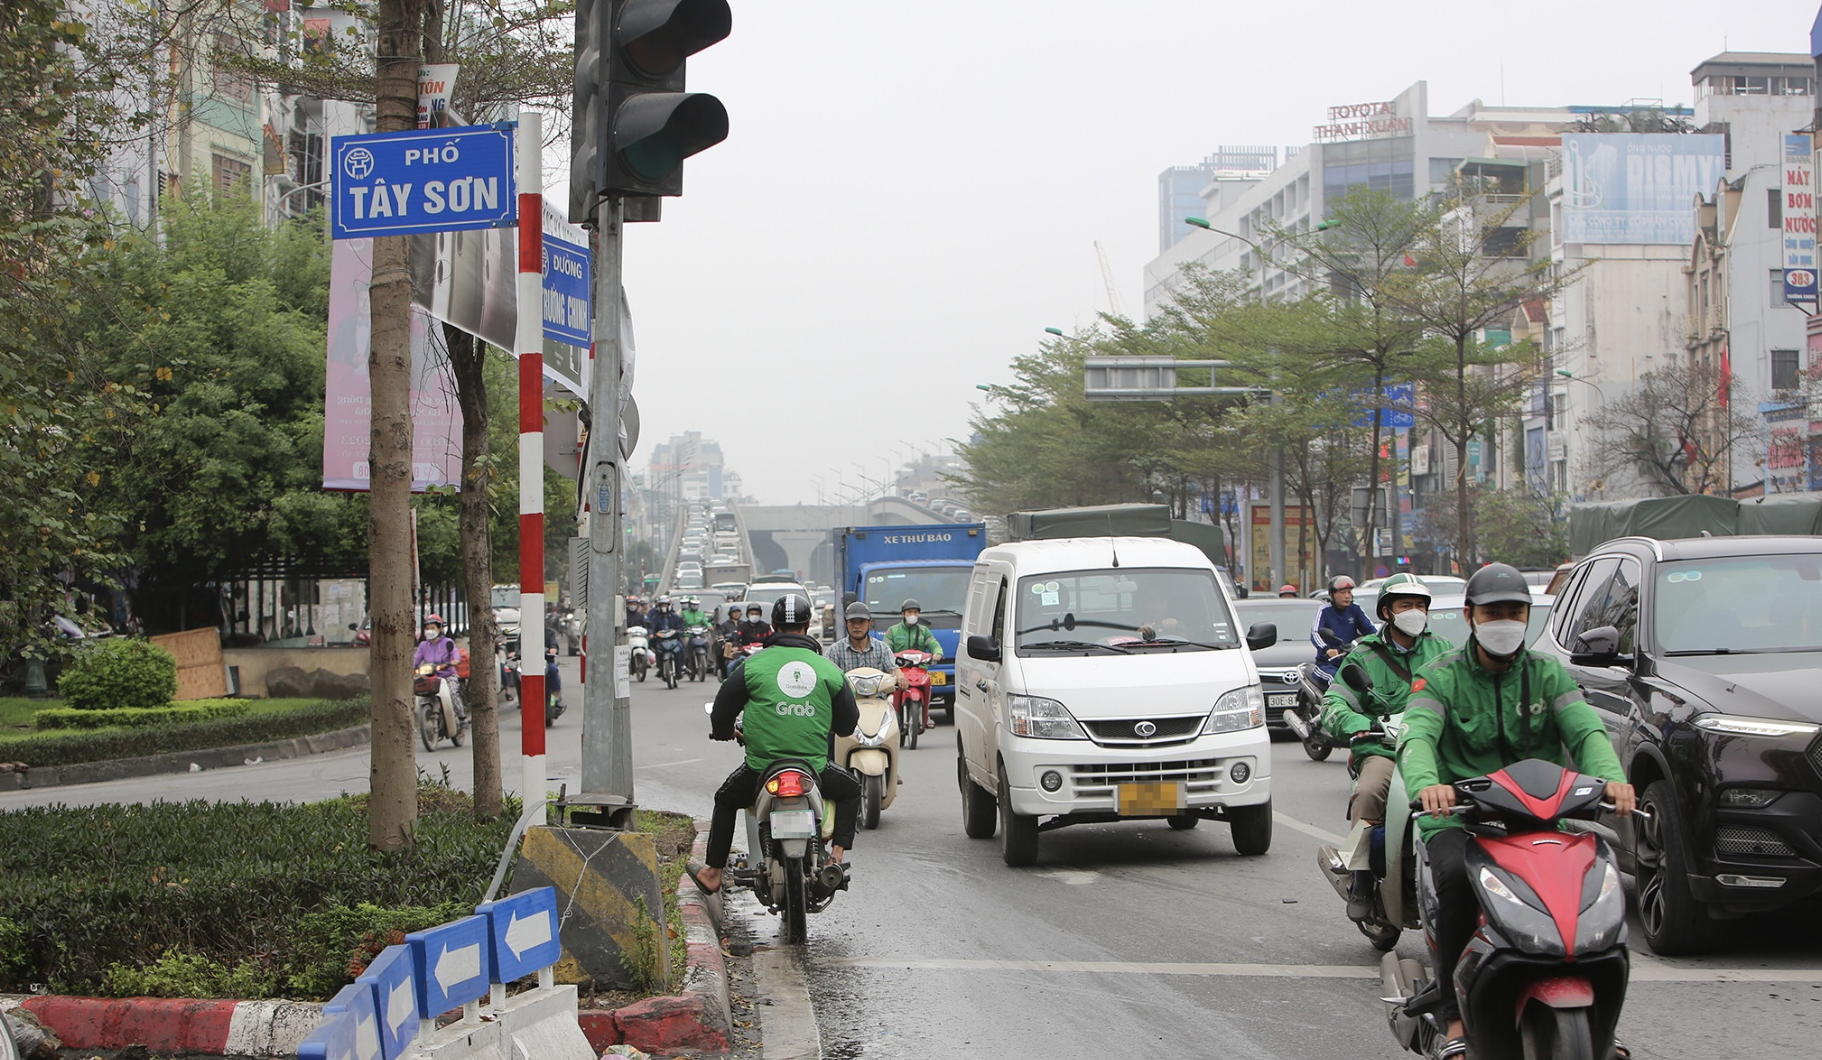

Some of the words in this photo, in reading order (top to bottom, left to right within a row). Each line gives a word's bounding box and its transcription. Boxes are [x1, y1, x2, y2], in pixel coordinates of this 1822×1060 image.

[1329, 102, 1390, 118] TOYOTA
[1315, 122, 1363, 138] THANH
[405, 138, 461, 166] PHỐ
[1626, 154, 1714, 188] DISMY
[1787, 166, 1811, 185] MÁY
[349, 178, 413, 220] TÂY
[423, 176, 498, 214] SƠN
[1788, 192, 1812, 208] BƠM
[1785, 213, 1816, 232] NƯỚC
[553, 251, 582, 280] ĐƯỜNG
[1791, 273, 1810, 285] 363
[543, 283, 565, 326] RƯỜNG
[567, 295, 588, 332] CHINH
[884, 535, 898, 544] XE
[900, 533, 926, 543] THƯ
[927, 532, 951, 542] BÁO
[776, 700, 815, 717] Grab
